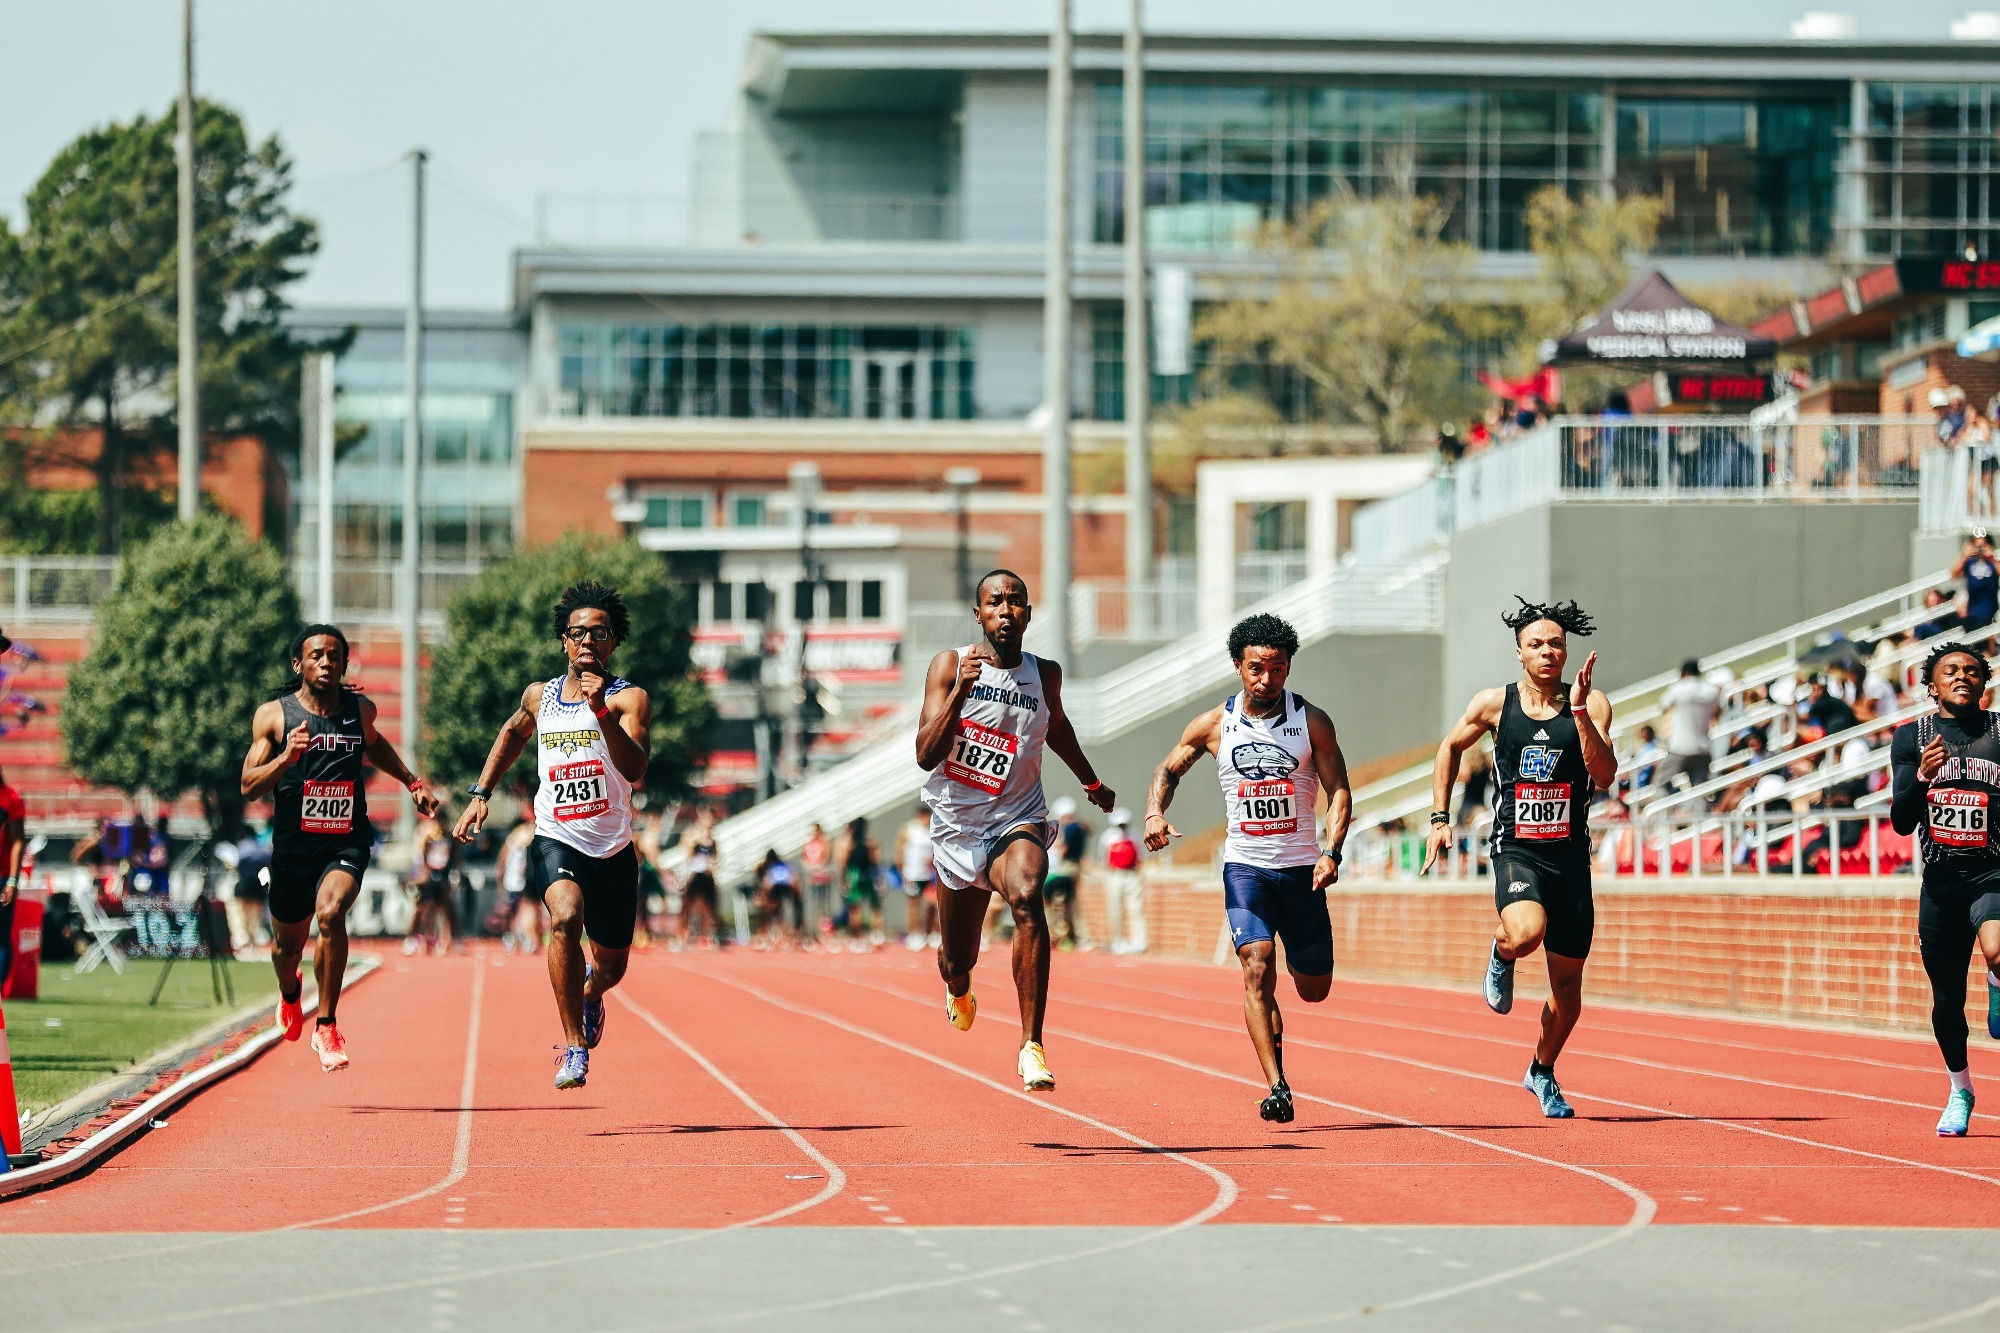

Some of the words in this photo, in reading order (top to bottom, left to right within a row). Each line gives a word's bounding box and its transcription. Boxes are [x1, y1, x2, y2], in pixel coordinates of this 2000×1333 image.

[967, 685, 1039, 712] UMBERLANDS
[963, 726, 979, 740] NC
[979, 732, 1011, 751] STATE
[955, 740, 1009, 776] 1878
[554, 769, 567, 780] NC
[569, 765, 597, 777] STATE
[969, 773, 1001, 789] adidas
[309, 786, 322, 796] NC
[324, 786, 349, 797] STATE
[554, 779, 601, 804] 2431
[1243, 785, 1257, 797] NC
[1258, 784, 1288, 796] STATE
[1521, 788, 1535, 799] NC
[1536, 788, 1565, 800] STATE
[1933, 792, 1949, 804] NC
[1950, 794, 1981, 806] STATE
[305, 799, 351, 819] 2402
[576, 802, 606, 814] adidas
[1243, 798, 1290, 820] 1601
[1518, 801, 1567, 822] 2087
[323, 821, 349, 829] adidas
[1931, 805, 1984, 830] 2216
[1264, 821, 1294, 831] adidas
[1539, 824, 1567, 834] adidas
[1952, 832, 1984, 841] adidas
